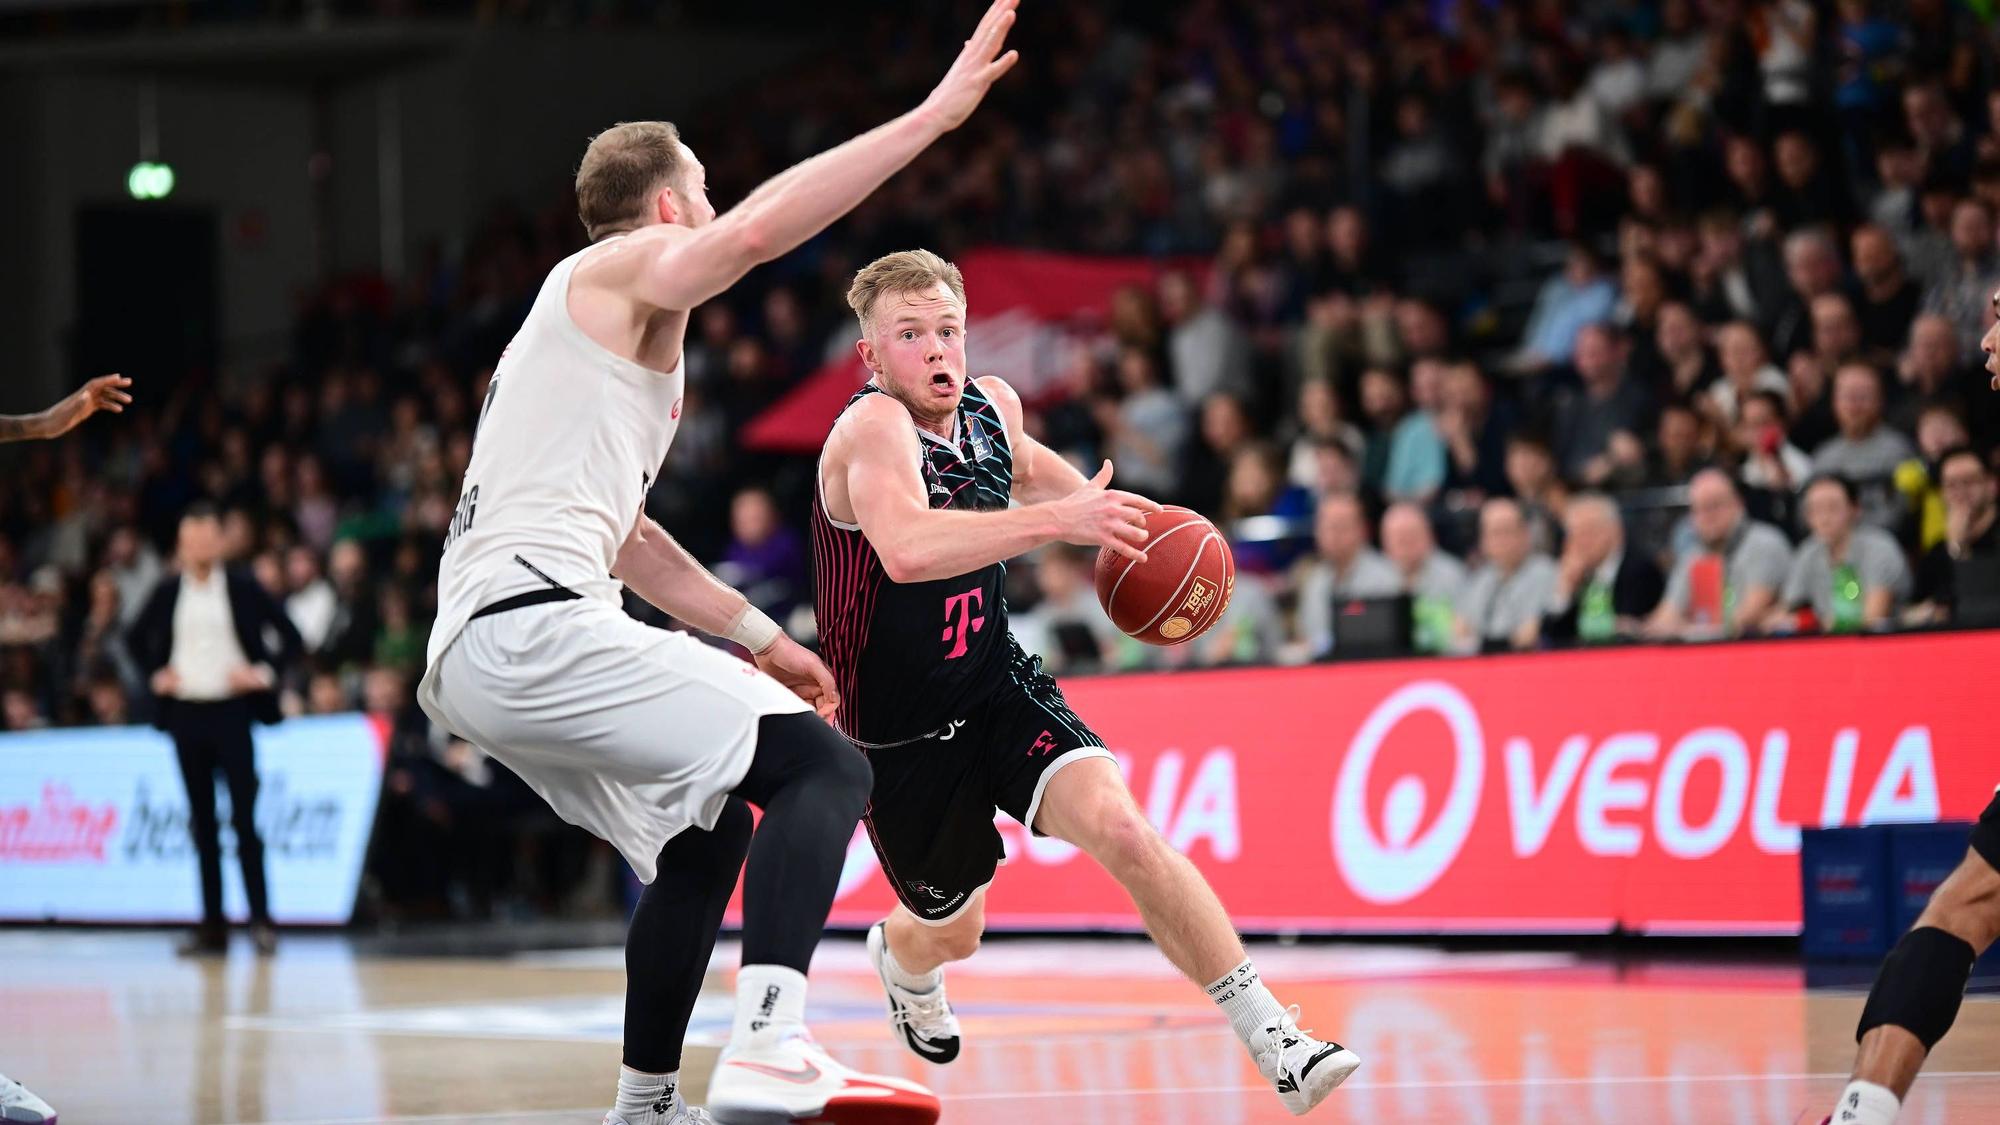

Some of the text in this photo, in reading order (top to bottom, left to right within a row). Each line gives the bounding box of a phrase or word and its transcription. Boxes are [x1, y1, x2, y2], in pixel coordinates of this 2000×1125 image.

[1181, 582, 1206, 611] BBL
[942, 586, 985, 660] T
[1504, 726, 1940, 860] VEOLIA
[925, 891, 964, 915] SPALDING
